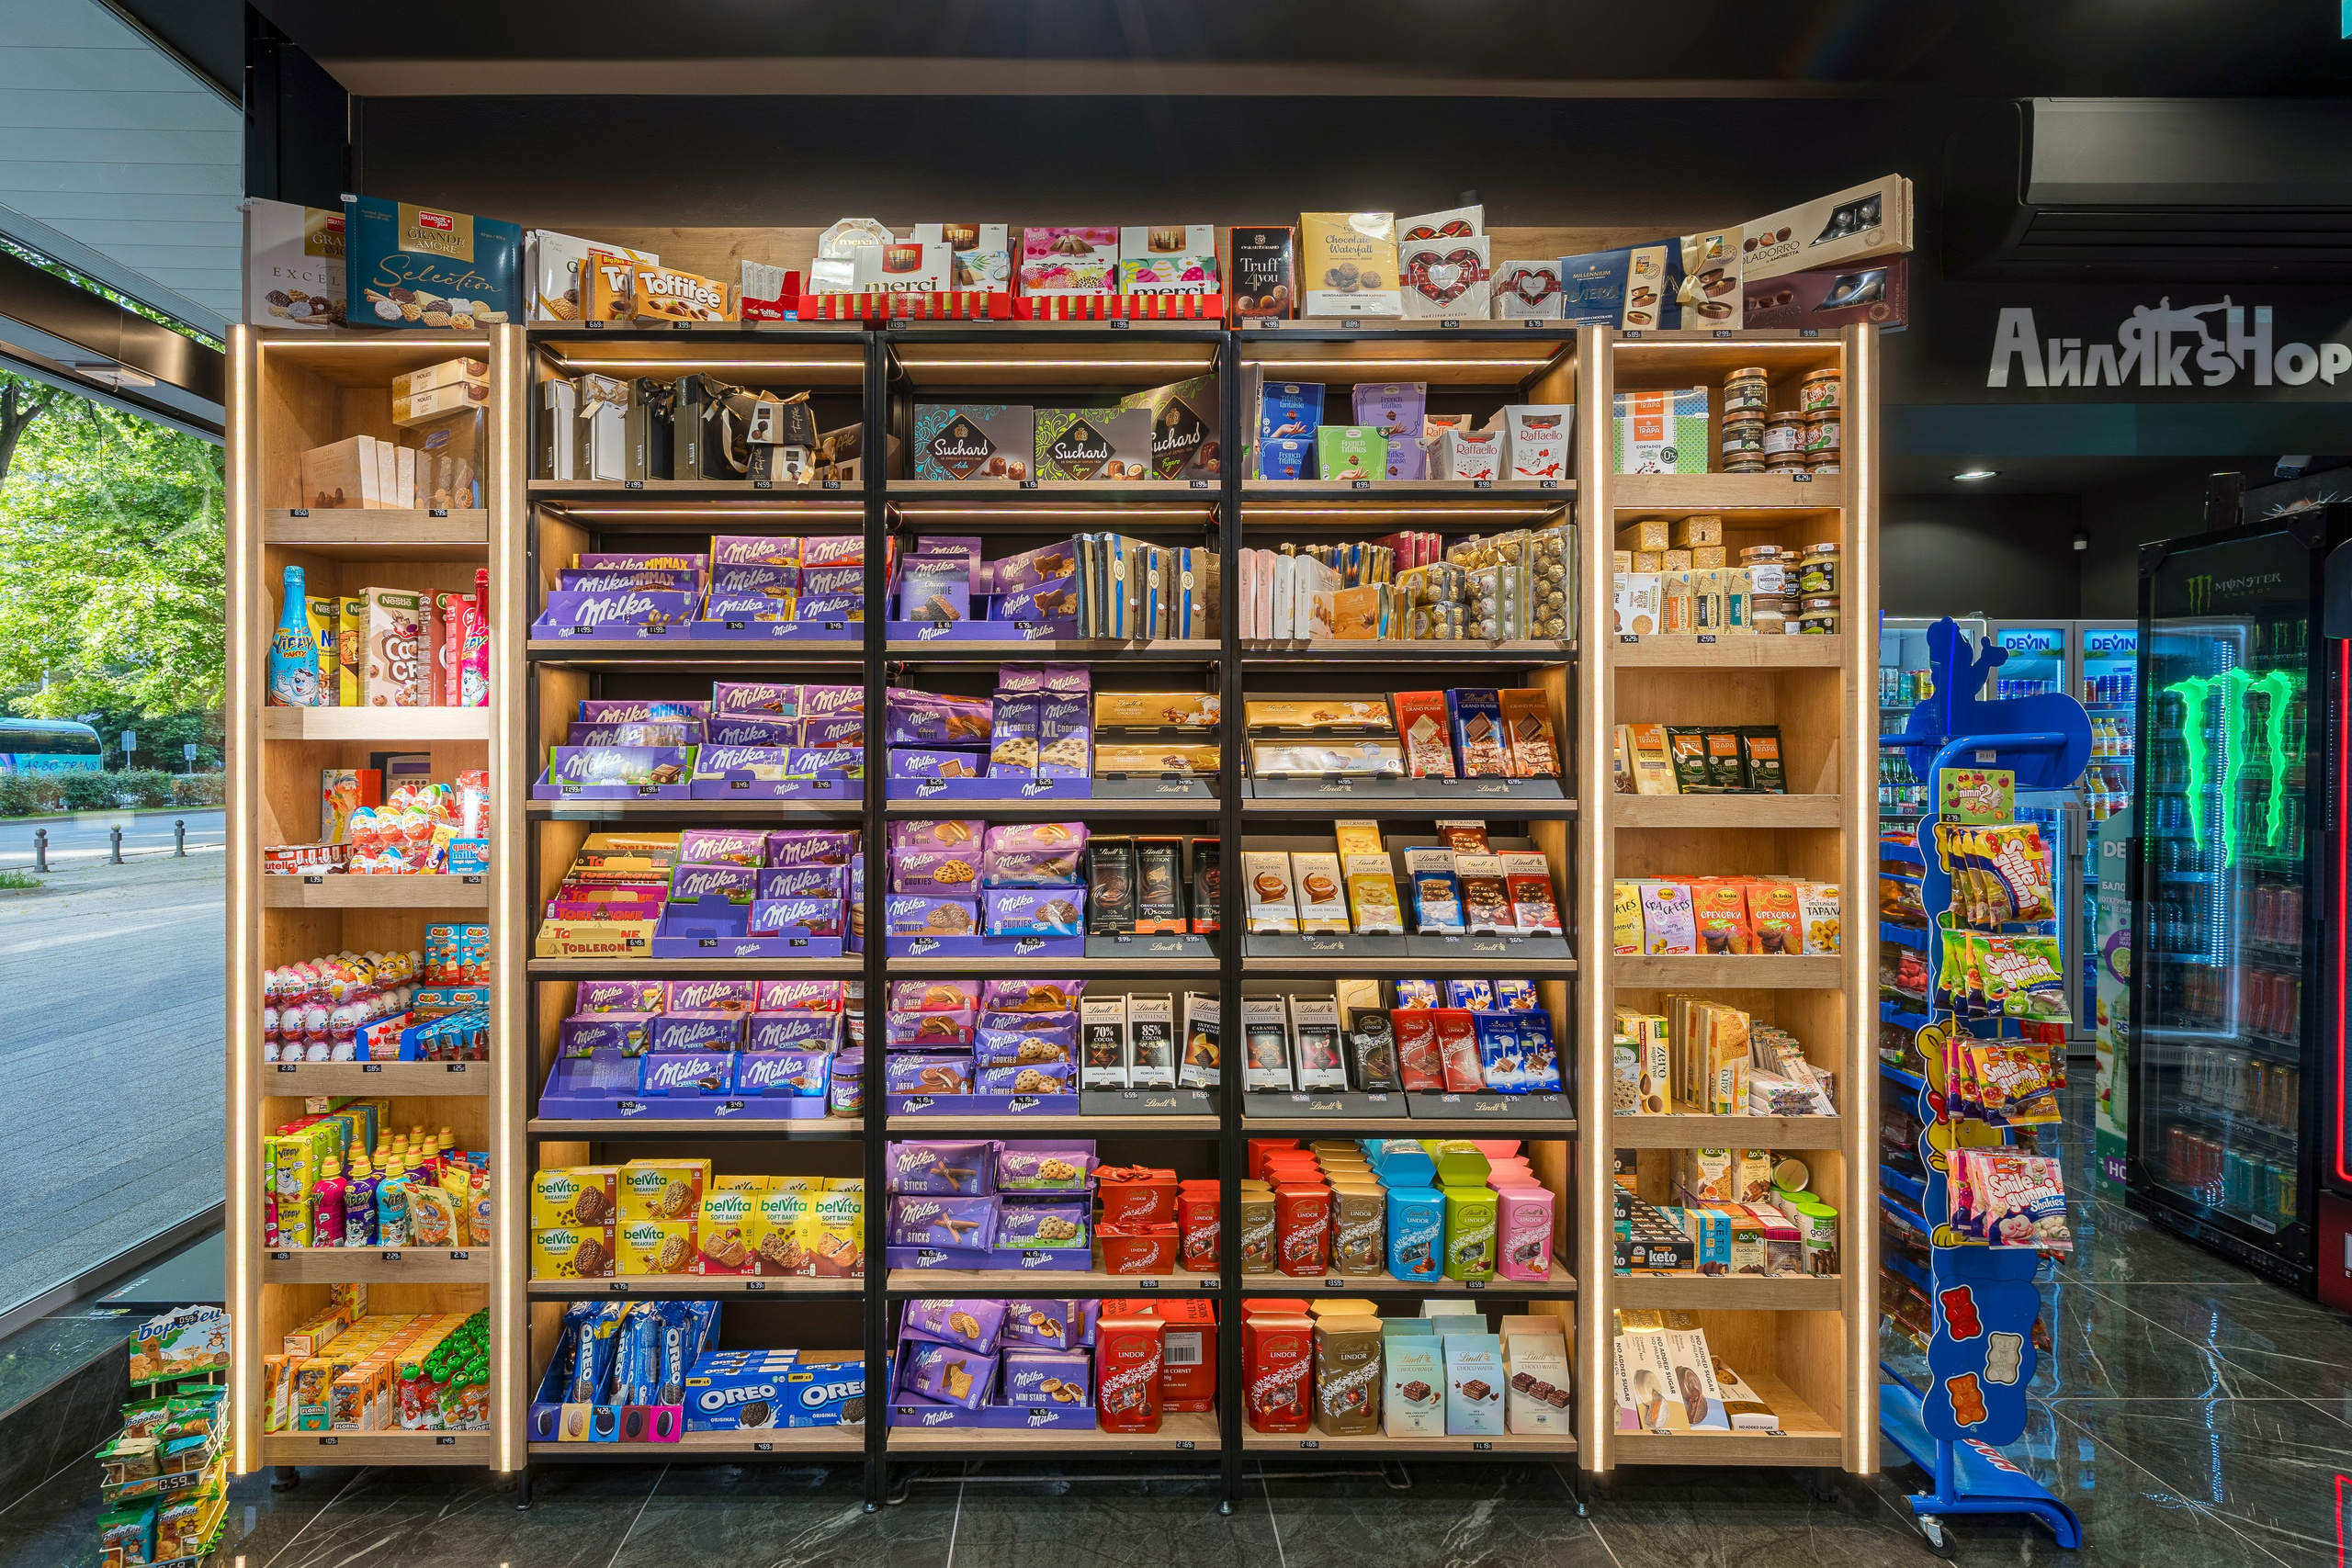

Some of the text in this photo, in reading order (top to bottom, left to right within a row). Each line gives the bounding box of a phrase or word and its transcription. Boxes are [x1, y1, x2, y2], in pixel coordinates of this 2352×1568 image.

[407, 229, 465, 247] GRANDE
[839, 238, 873, 246] merci
[1325, 234, 1372, 245] Chocolate
[415, 240, 458, 254] AMORE
[1329, 243, 1374, 255] Waterfall
[1240, 257, 1281, 273] Truff
[373, 254, 502, 293] Selection
[1572, 271, 1611, 279] MILLENNIUM
[639, 272, 722, 309] Toffifee
[865, 278, 938, 292] merci
[1520, 430, 1563, 442] Raffaello
[1637, 424, 1661, 434] TRAPA
[934, 438, 989, 457] Suchard
[1054, 442, 1108, 459] Suchard
[1456, 444, 1498, 456] Raffaello
[723, 539, 776, 563] Milka
[2215, 572, 2282, 592] MONSTER
[2225, 587, 2271, 599] ENERGY
[575, 592, 655, 626] Milka
[772, 624, 799, 637] Milka
[2007, 637, 2050, 650] DEVIN
[2092, 637, 2136, 650] DEVIN
[726, 687, 777, 708] Milka
[994, 721, 1035, 738] XL COOKIES
[1753, 744, 1776, 752] TRAPA
[62, 761, 97, 772] TRANS
[709, 748, 766, 770] Milka
[797, 750, 853, 770] Milka
[452, 842, 477, 852] quick
[690, 837, 743, 859] Milka
[1417, 854, 1442, 863] Lindt
[2002, 839, 2036, 886] Smile
[905, 877, 933, 886] COOKIES
[1993, 854, 2040, 908] gummi
[763, 901, 818, 926] Milka
[1701, 910, 1742, 919] ОРЕХОВКИ
[561, 942, 634, 955] TOBLERONE
[1311, 942, 1337, 951] Lindt
[1984, 952, 2029, 976] Smile
[905, 998, 922, 1007] JAFFA
[662, 1023, 717, 1044] Milka
[1093, 1026, 1114, 1037] 70%
[1142, 1025, 1162, 1035] 85%
[653, 1058, 712, 1086] Milka
[1983, 1060, 2018, 1082] Smile
[1997, 1064, 2041, 1093] gummi
[2010, 1077, 2048, 1099] Softies
[627, 1171, 667, 1186] belVita
[537, 1179, 580, 1194] belVita
[2006, 1178, 2057, 1213] gummi
[705, 1196, 752, 1213] belVita
[900, 1201, 941, 1222] Milka
[2030, 1197, 2064, 1212] Shakies
[907, 1232, 930, 1243] STICKS
[1010, 1235, 1035, 1244] COOKIES
[1648, 1251, 1678, 1262] keto
[581, 1323, 593, 1382] OREO
[668, 1328, 681, 1385] OREO
[1397, 1352, 1423, 1363] Lindt
[1458, 1351, 1484, 1361] Lindt
[700, 1384, 776, 1411] OREO
[802, 1381, 865, 1408] ORE
[1016, 1393, 1046, 1402] MINI STARS
[125, 1412, 165, 1427] Боровец
[158, 1506, 199, 1522] Боровец
